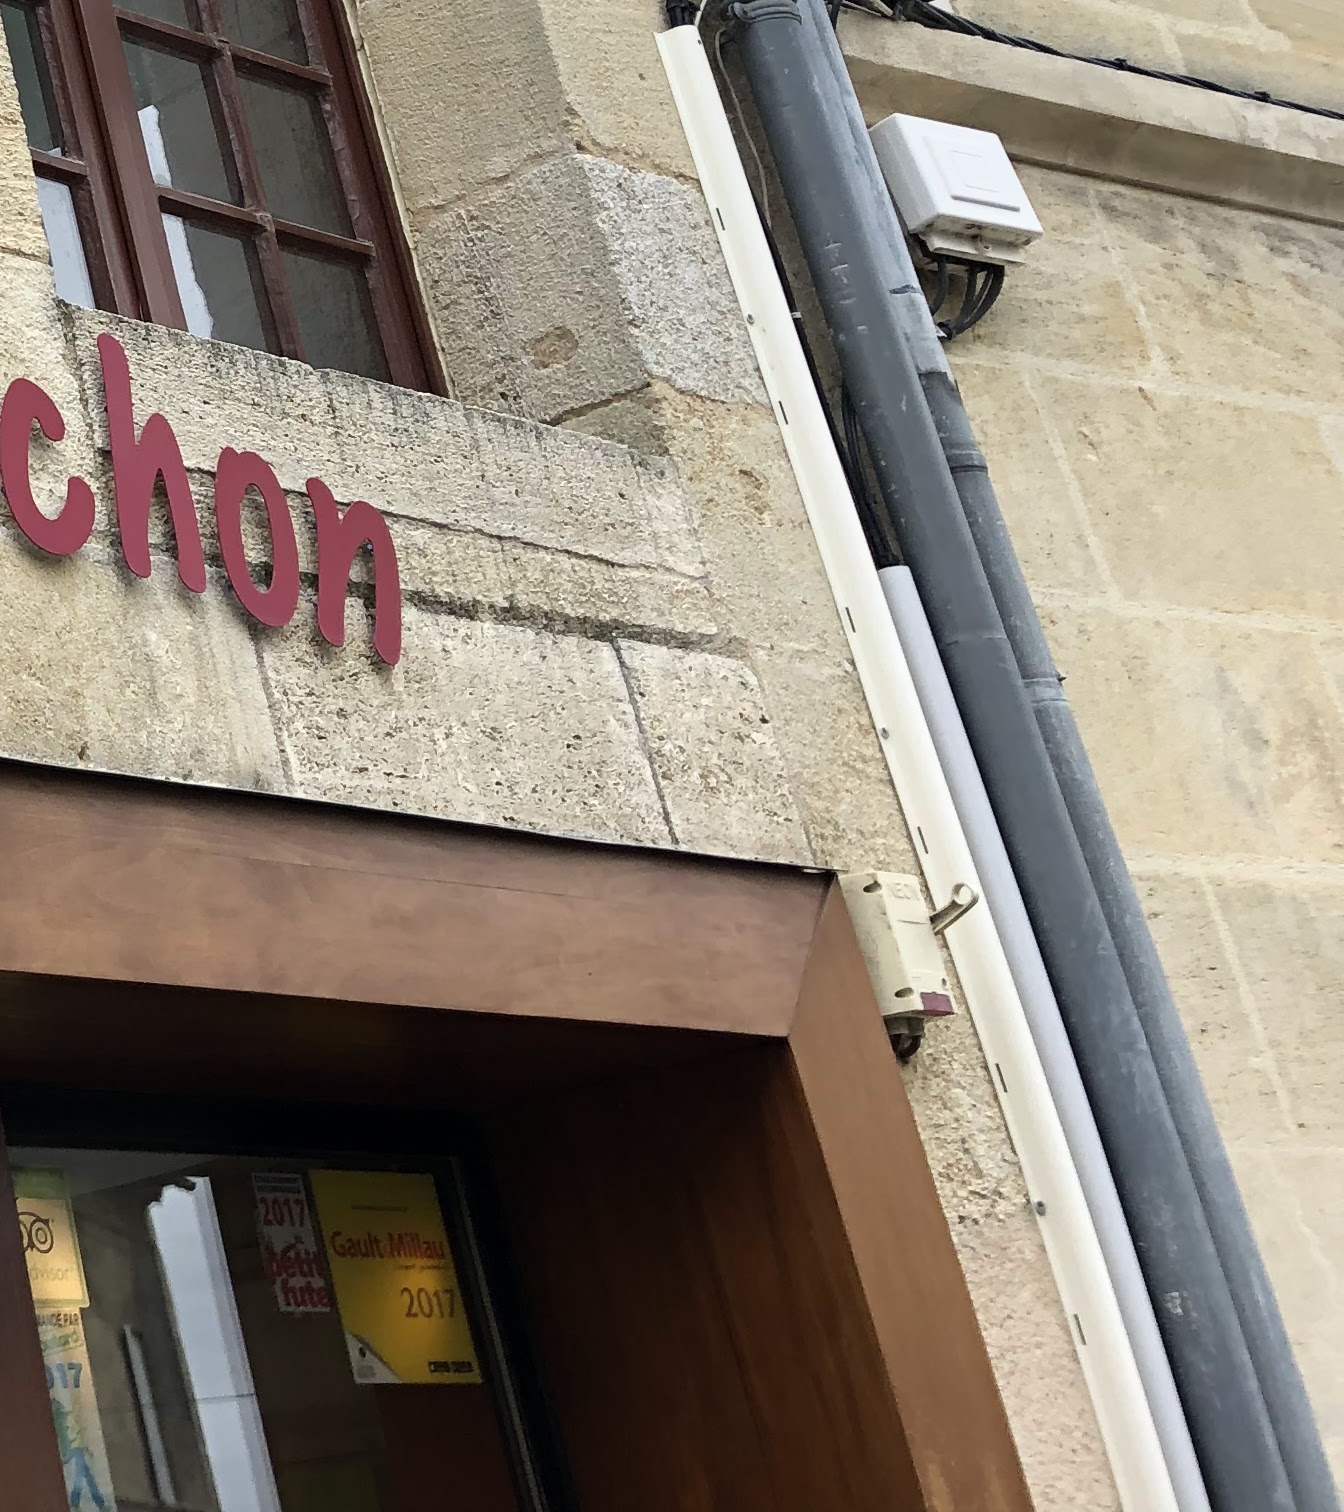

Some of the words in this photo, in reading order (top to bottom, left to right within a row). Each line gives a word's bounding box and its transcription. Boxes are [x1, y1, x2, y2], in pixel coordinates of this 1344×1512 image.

[258, 1196, 305, 1227] 2017
[331, 1230, 384, 1260] Gault
[388, 1232, 445, 1260] Millau
[400, 1286, 456, 1319] 2017
